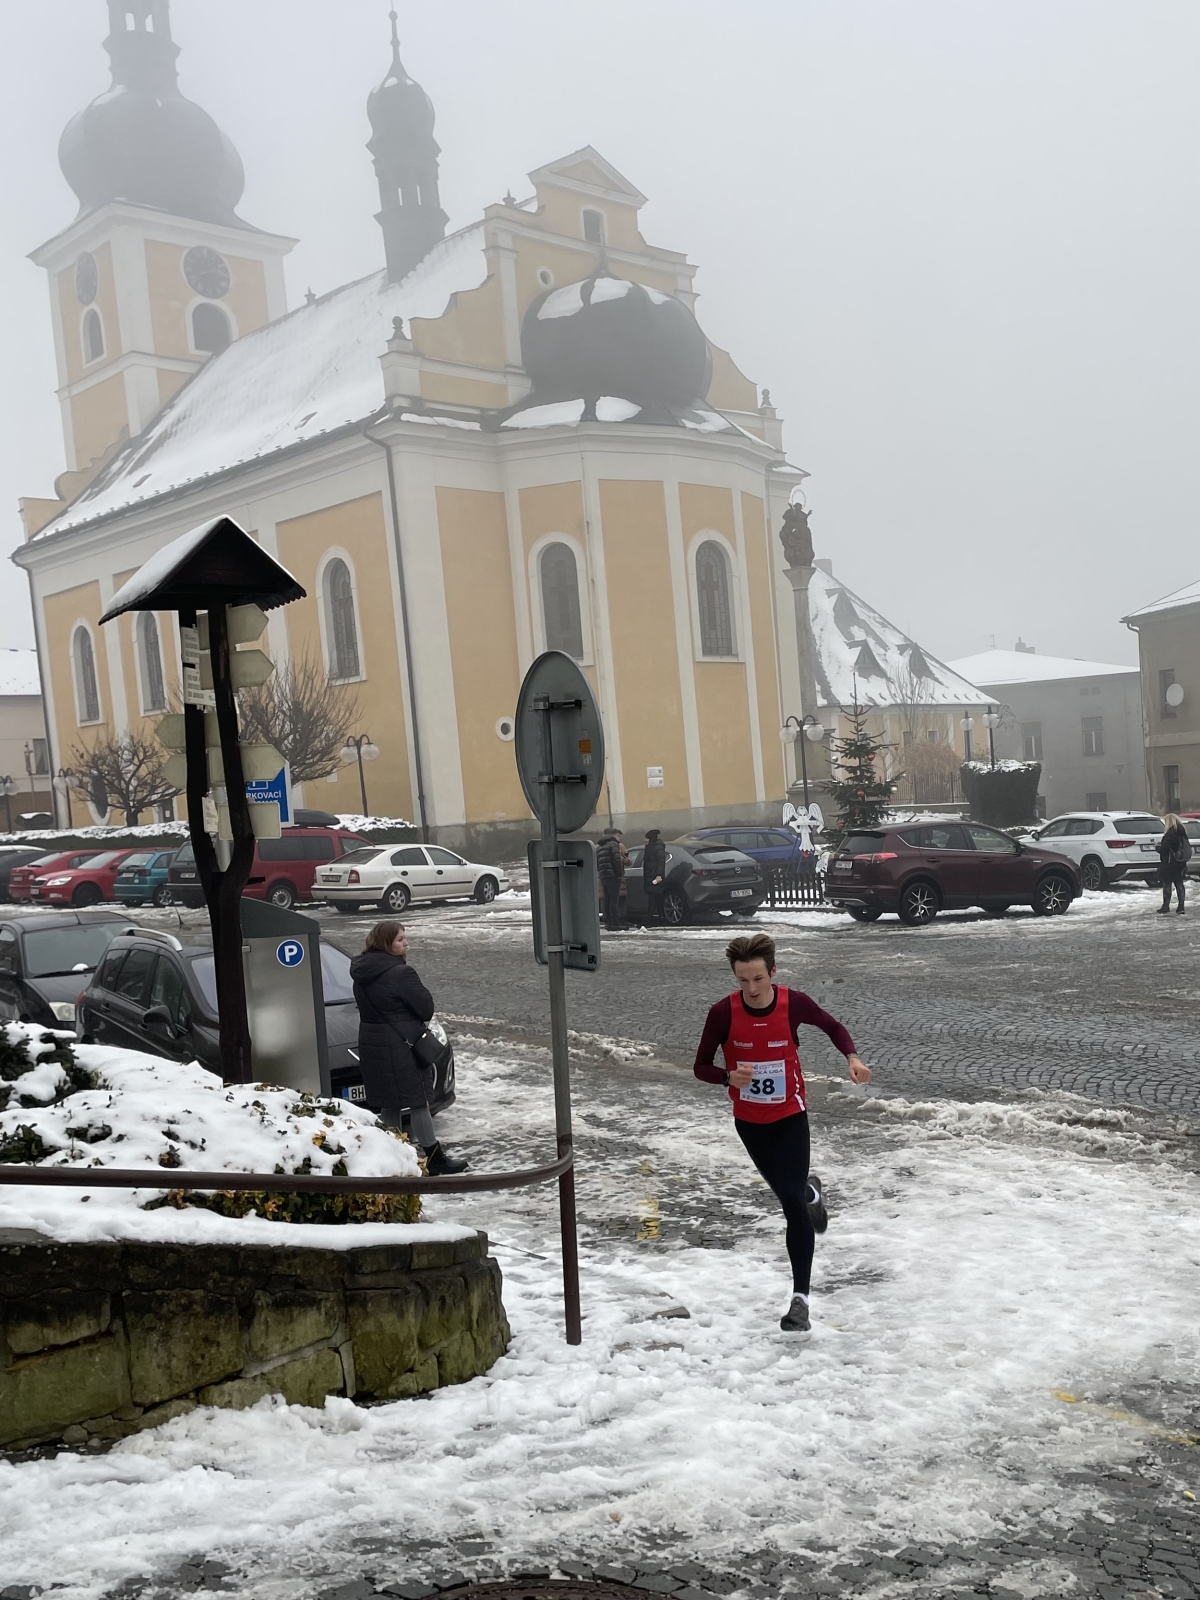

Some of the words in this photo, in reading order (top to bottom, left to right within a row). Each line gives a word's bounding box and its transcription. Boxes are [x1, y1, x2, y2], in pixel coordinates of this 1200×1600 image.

[246, 790, 281, 799] RKOVACÍ
[284, 945, 298, 962] P
[351, 1086, 365, 1099] 8H
[749, 1078, 776, 1095] 38
